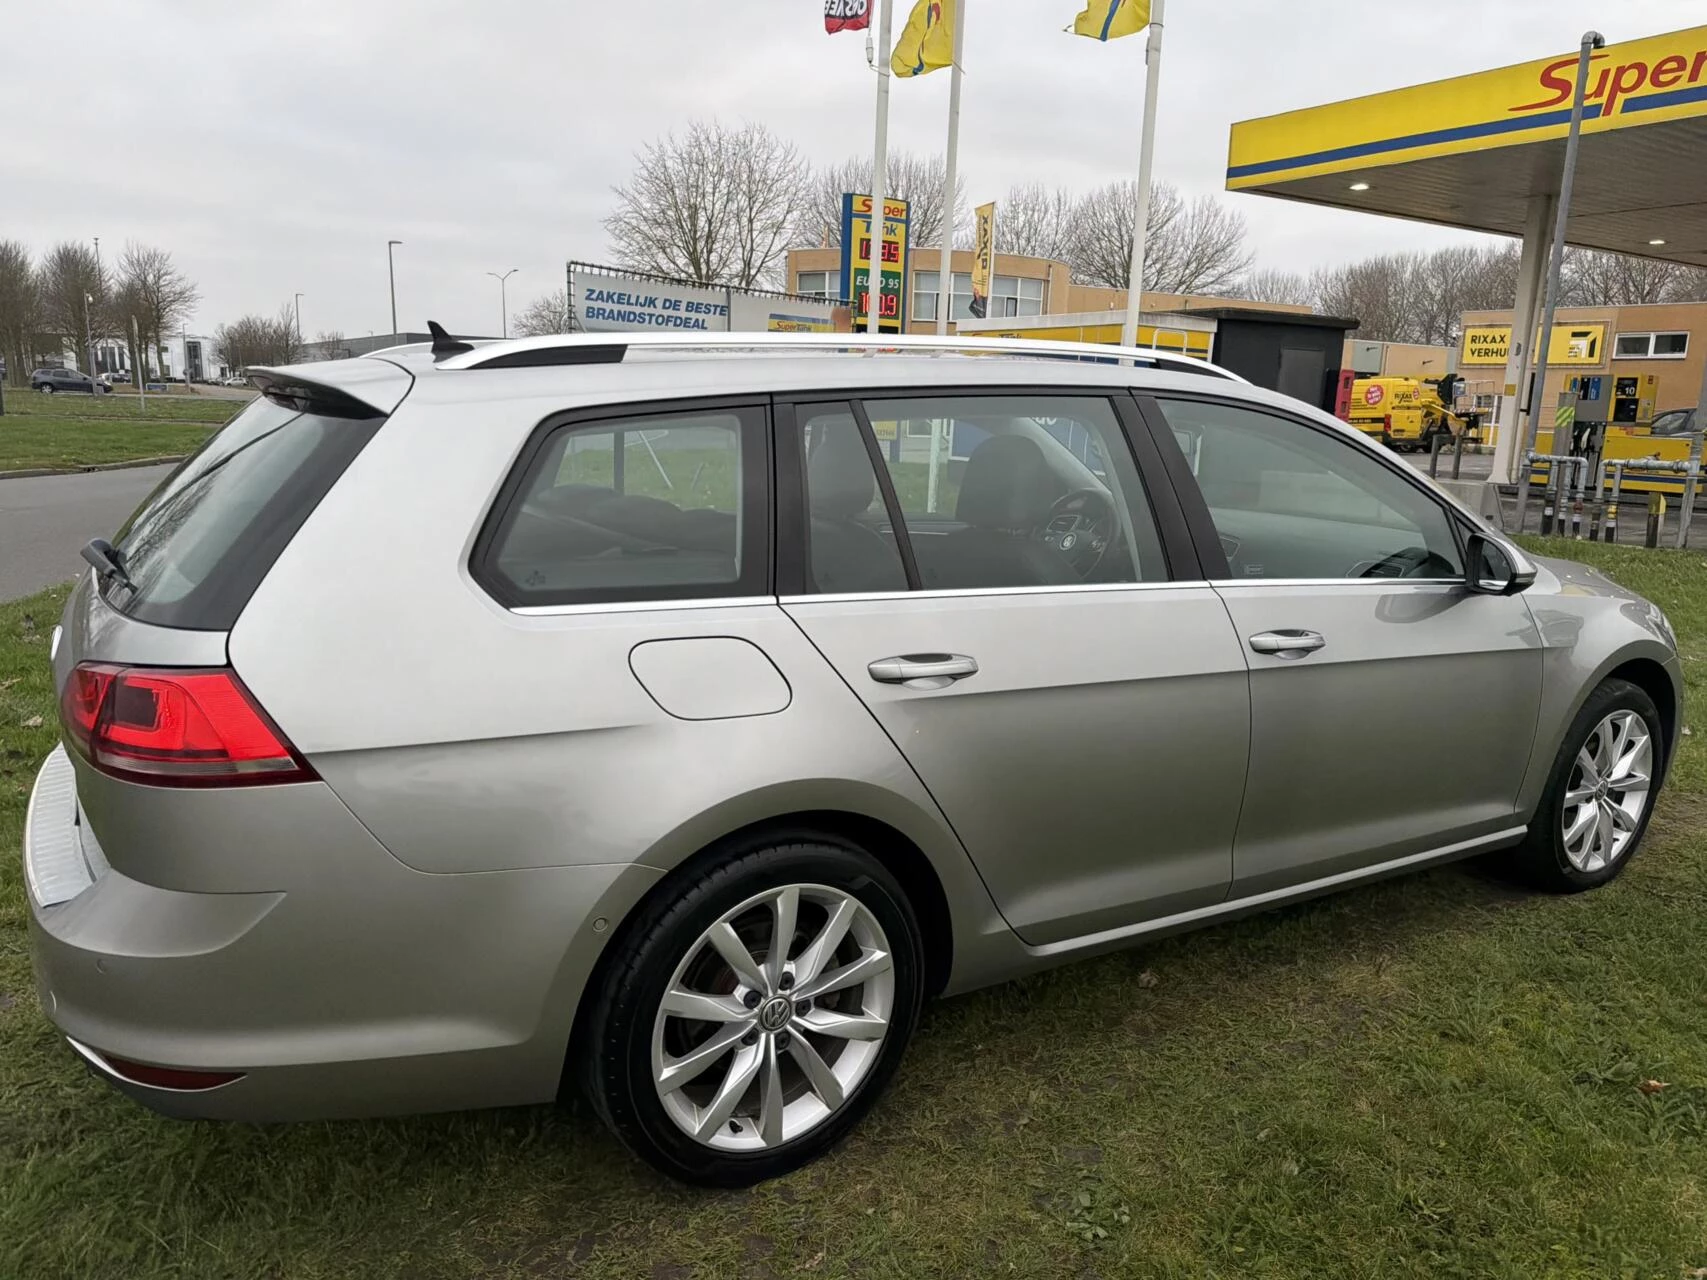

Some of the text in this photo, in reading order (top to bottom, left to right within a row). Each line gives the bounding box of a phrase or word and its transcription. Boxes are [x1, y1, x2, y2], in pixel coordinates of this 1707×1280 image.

[1508, 54, 1707, 117] Super
[853, 198, 906, 217] Sper
[861, 220, 898, 237] Tnk
[856, 275, 900, 289] EUO 95
[585, 288, 729, 317] ZAKELIJK DE BESTE
[585, 306, 708, 330] BRANDSTOFDEAL
[1470, 334, 1507, 345] RIXAX
[1470, 347, 1509, 358] VERHU
[1624, 386, 1636, 395] 10
